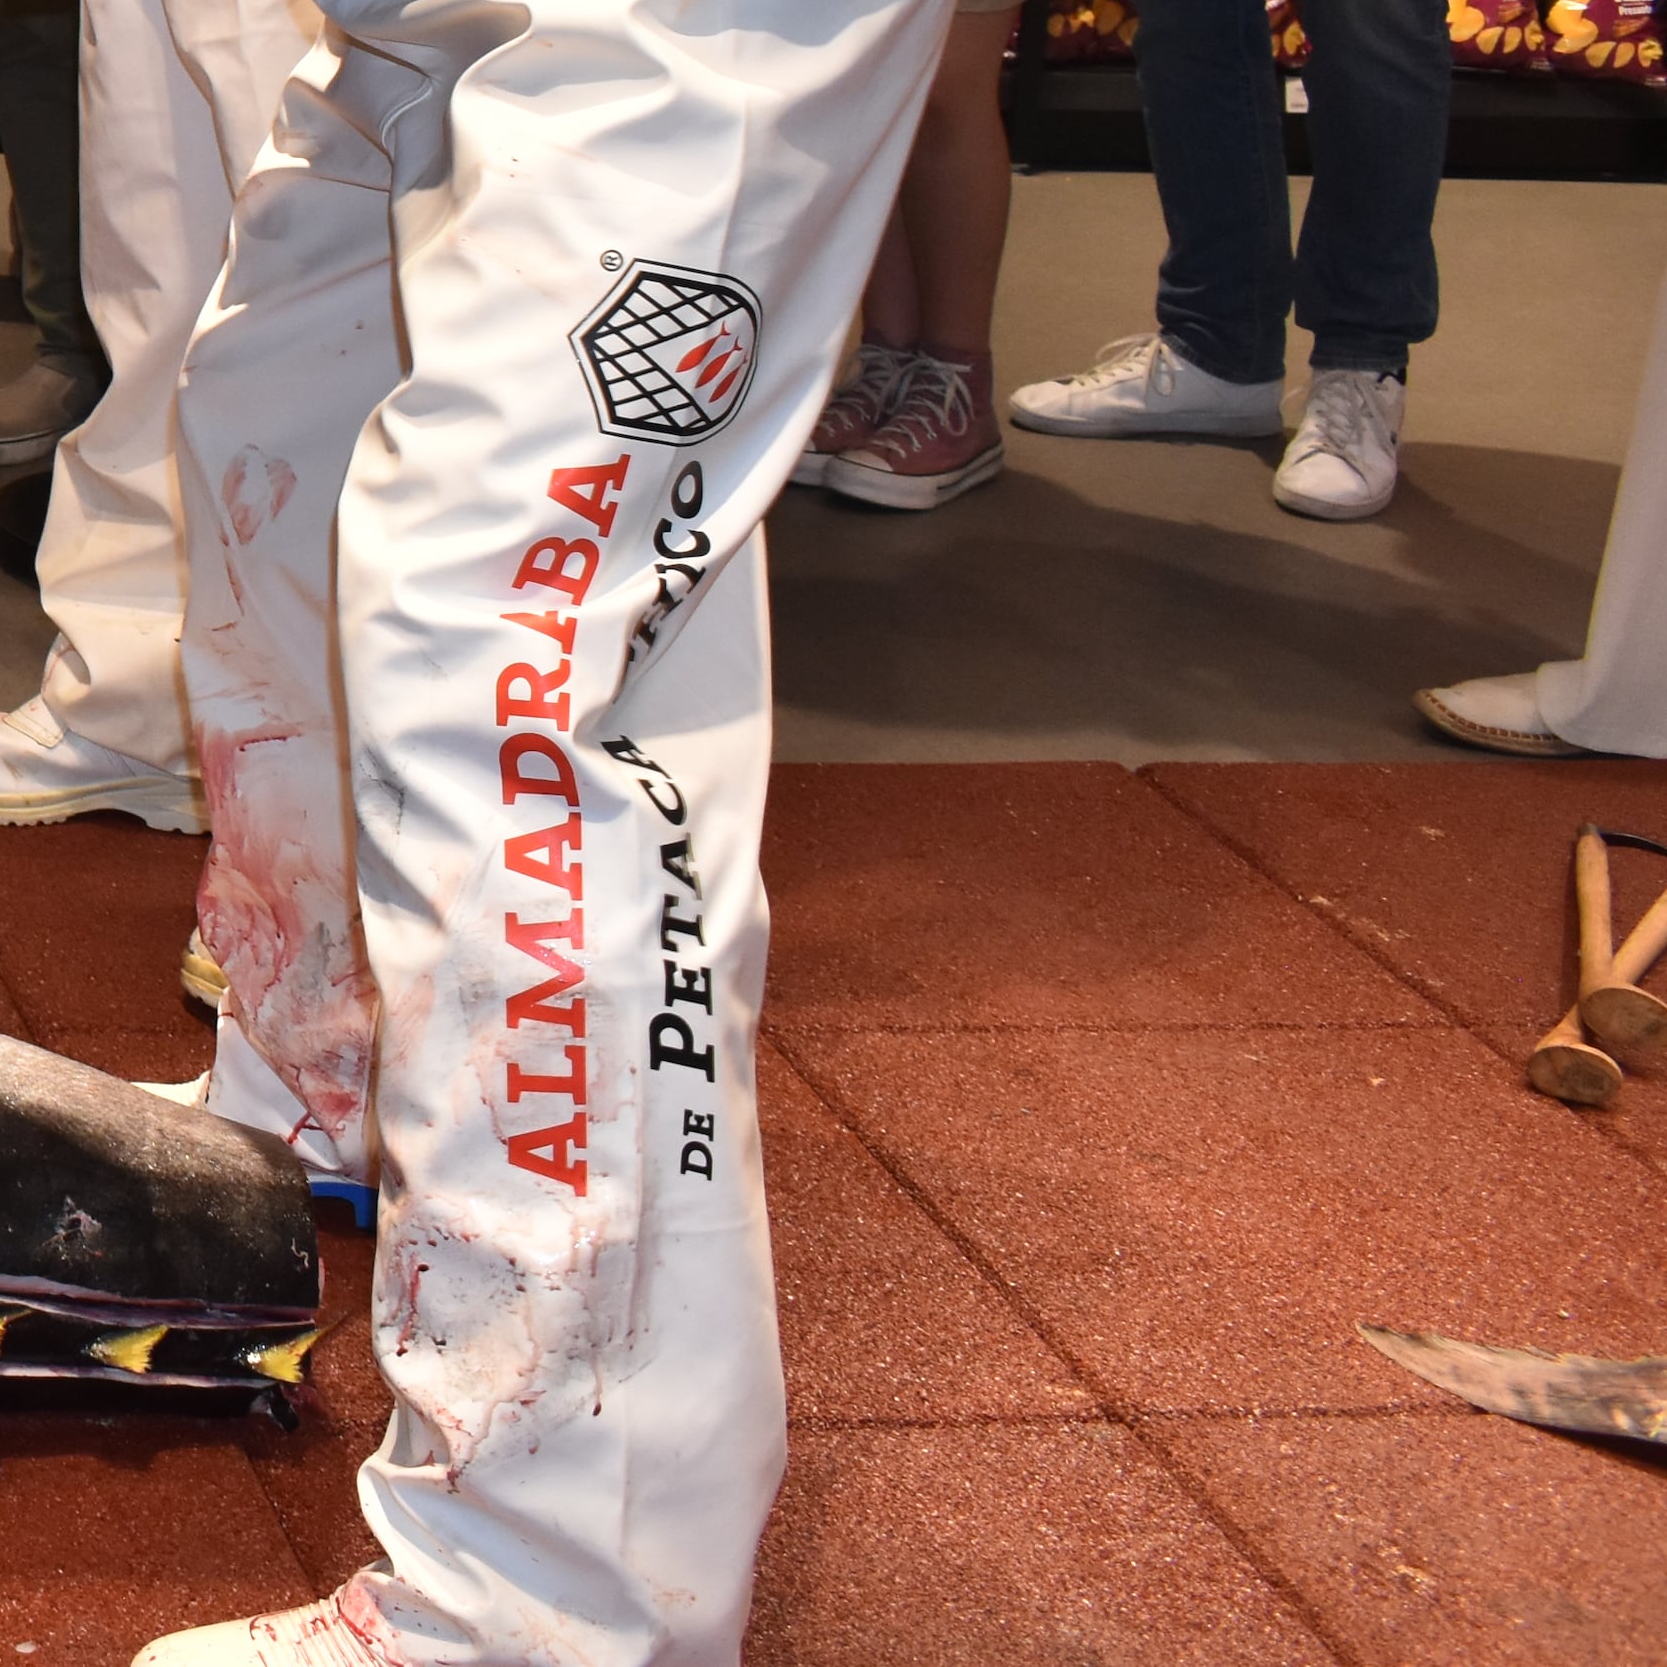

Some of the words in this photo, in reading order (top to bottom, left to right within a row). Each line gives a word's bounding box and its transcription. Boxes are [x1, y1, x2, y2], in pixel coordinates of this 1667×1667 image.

[497, 453, 631, 1198] ALMADRABA
[600, 734, 716, 1084] PETACA
[680, 1108, 715, 1181] DE
